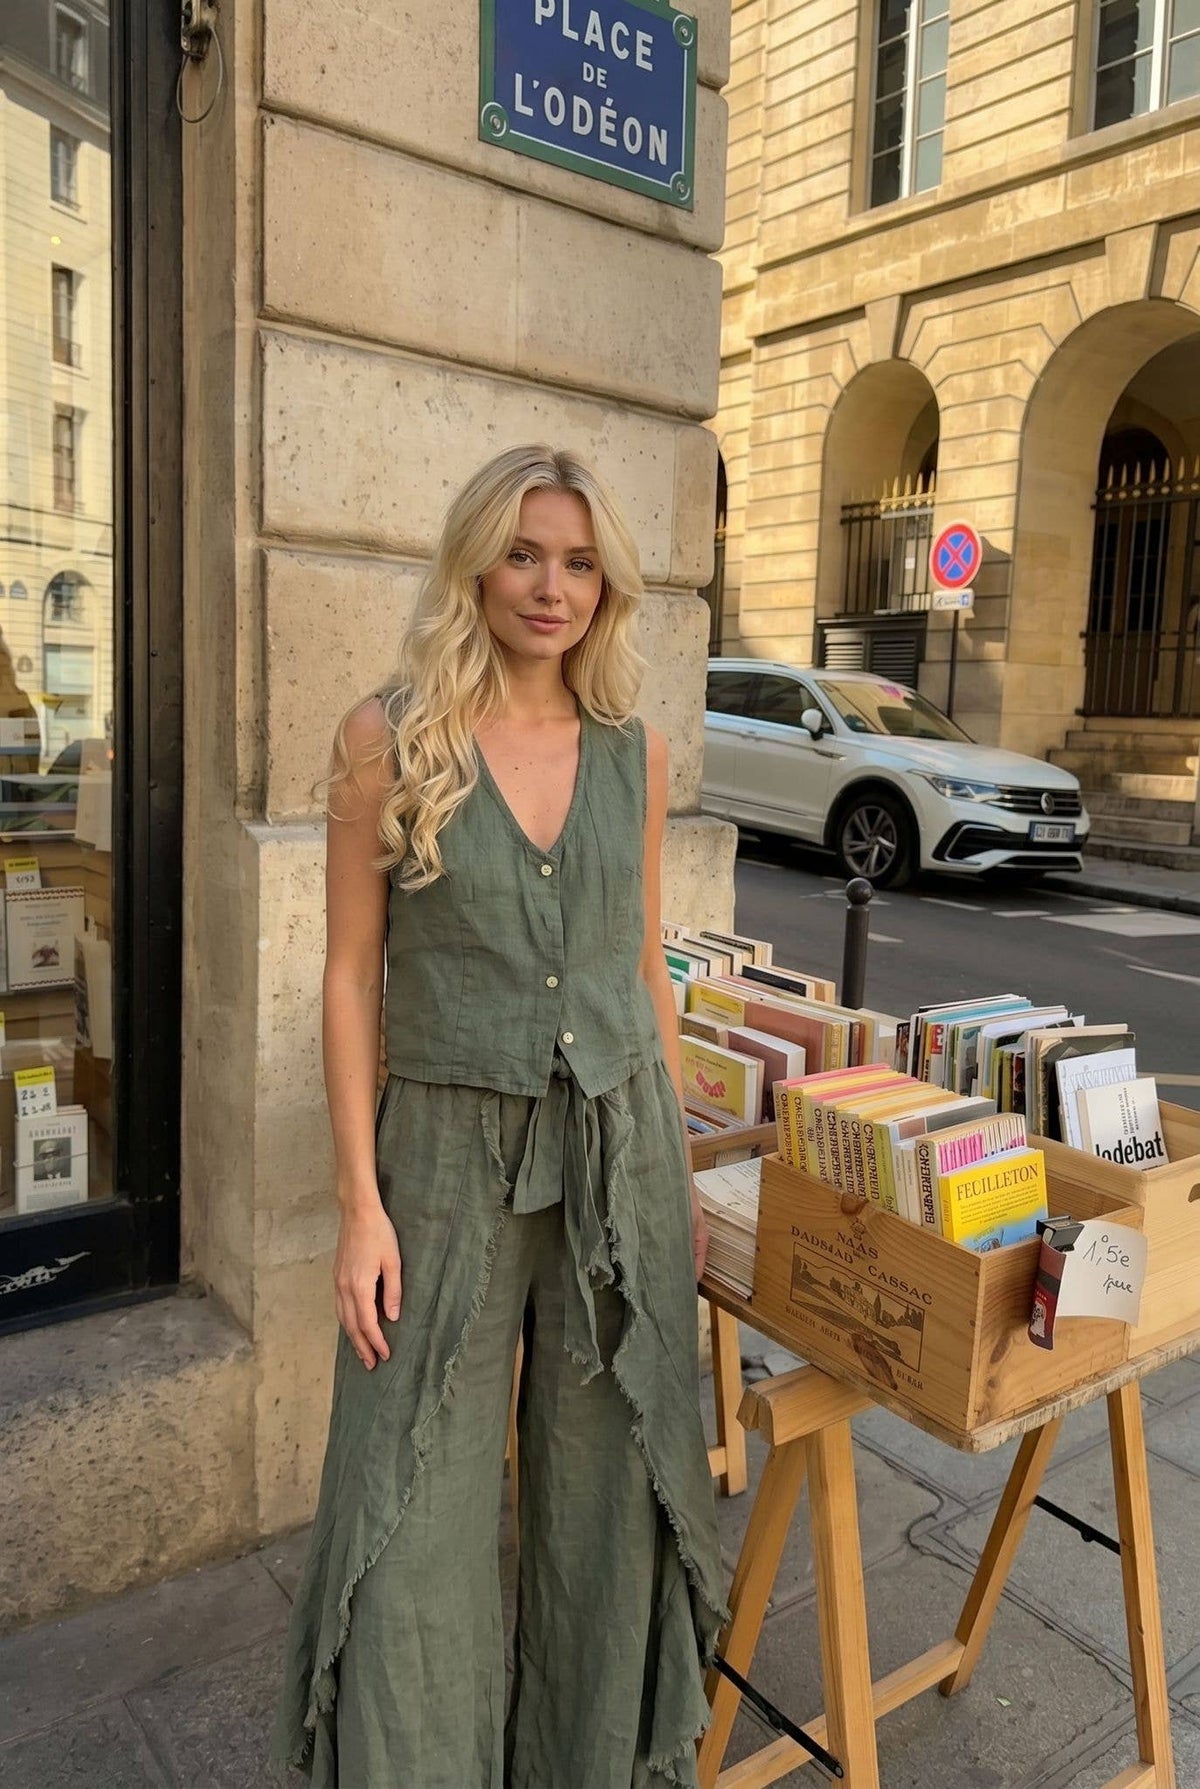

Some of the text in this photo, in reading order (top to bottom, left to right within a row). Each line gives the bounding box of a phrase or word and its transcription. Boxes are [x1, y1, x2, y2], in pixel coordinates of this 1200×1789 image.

[534, 0, 653, 72] PLACE
[582, 61, 608, 89] DE
[514, 72, 668, 166] L'ODÉON
